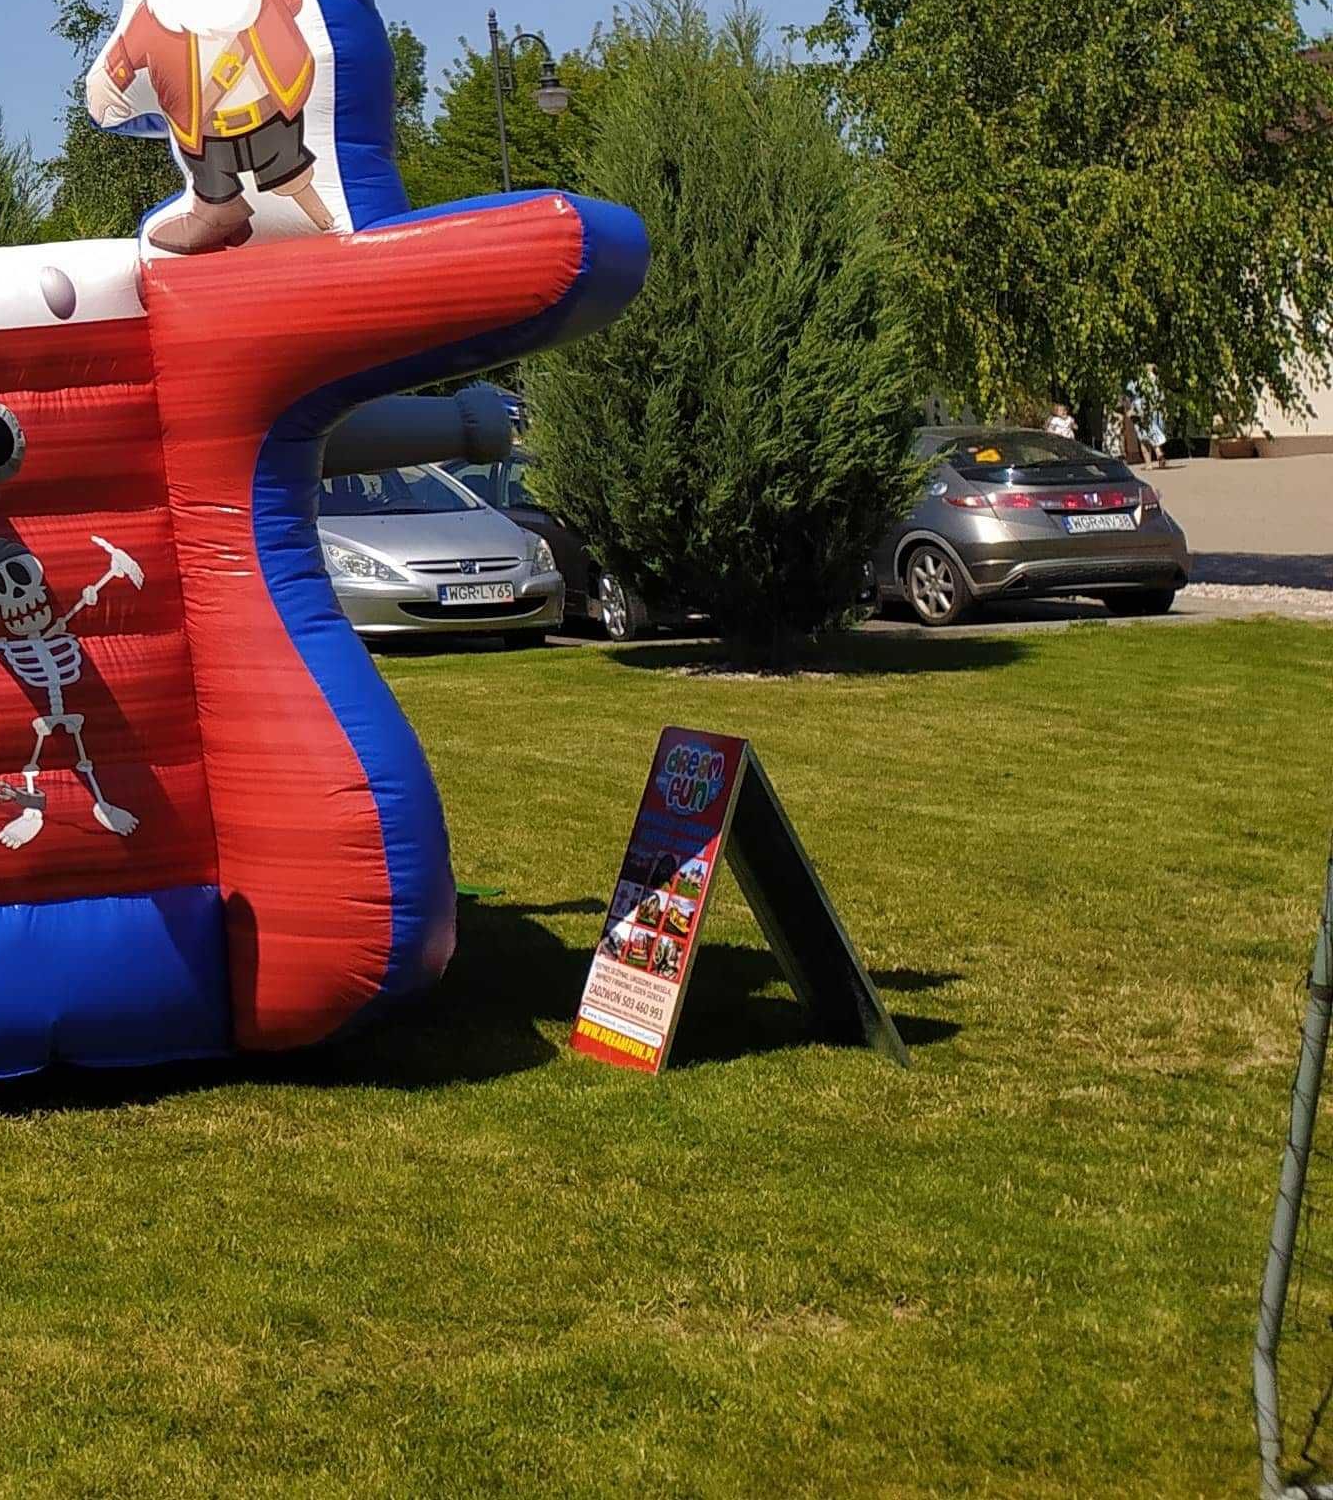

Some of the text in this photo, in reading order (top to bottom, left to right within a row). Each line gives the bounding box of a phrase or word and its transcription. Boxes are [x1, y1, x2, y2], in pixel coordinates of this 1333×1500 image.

[449, 584, 511, 600] WGR LY65
[589, 982, 620, 1005] ZADZWOŃ
[623, 995, 636, 1011] 503
[576, 1018, 658, 1065] WWW.DREAMFUN.PL
